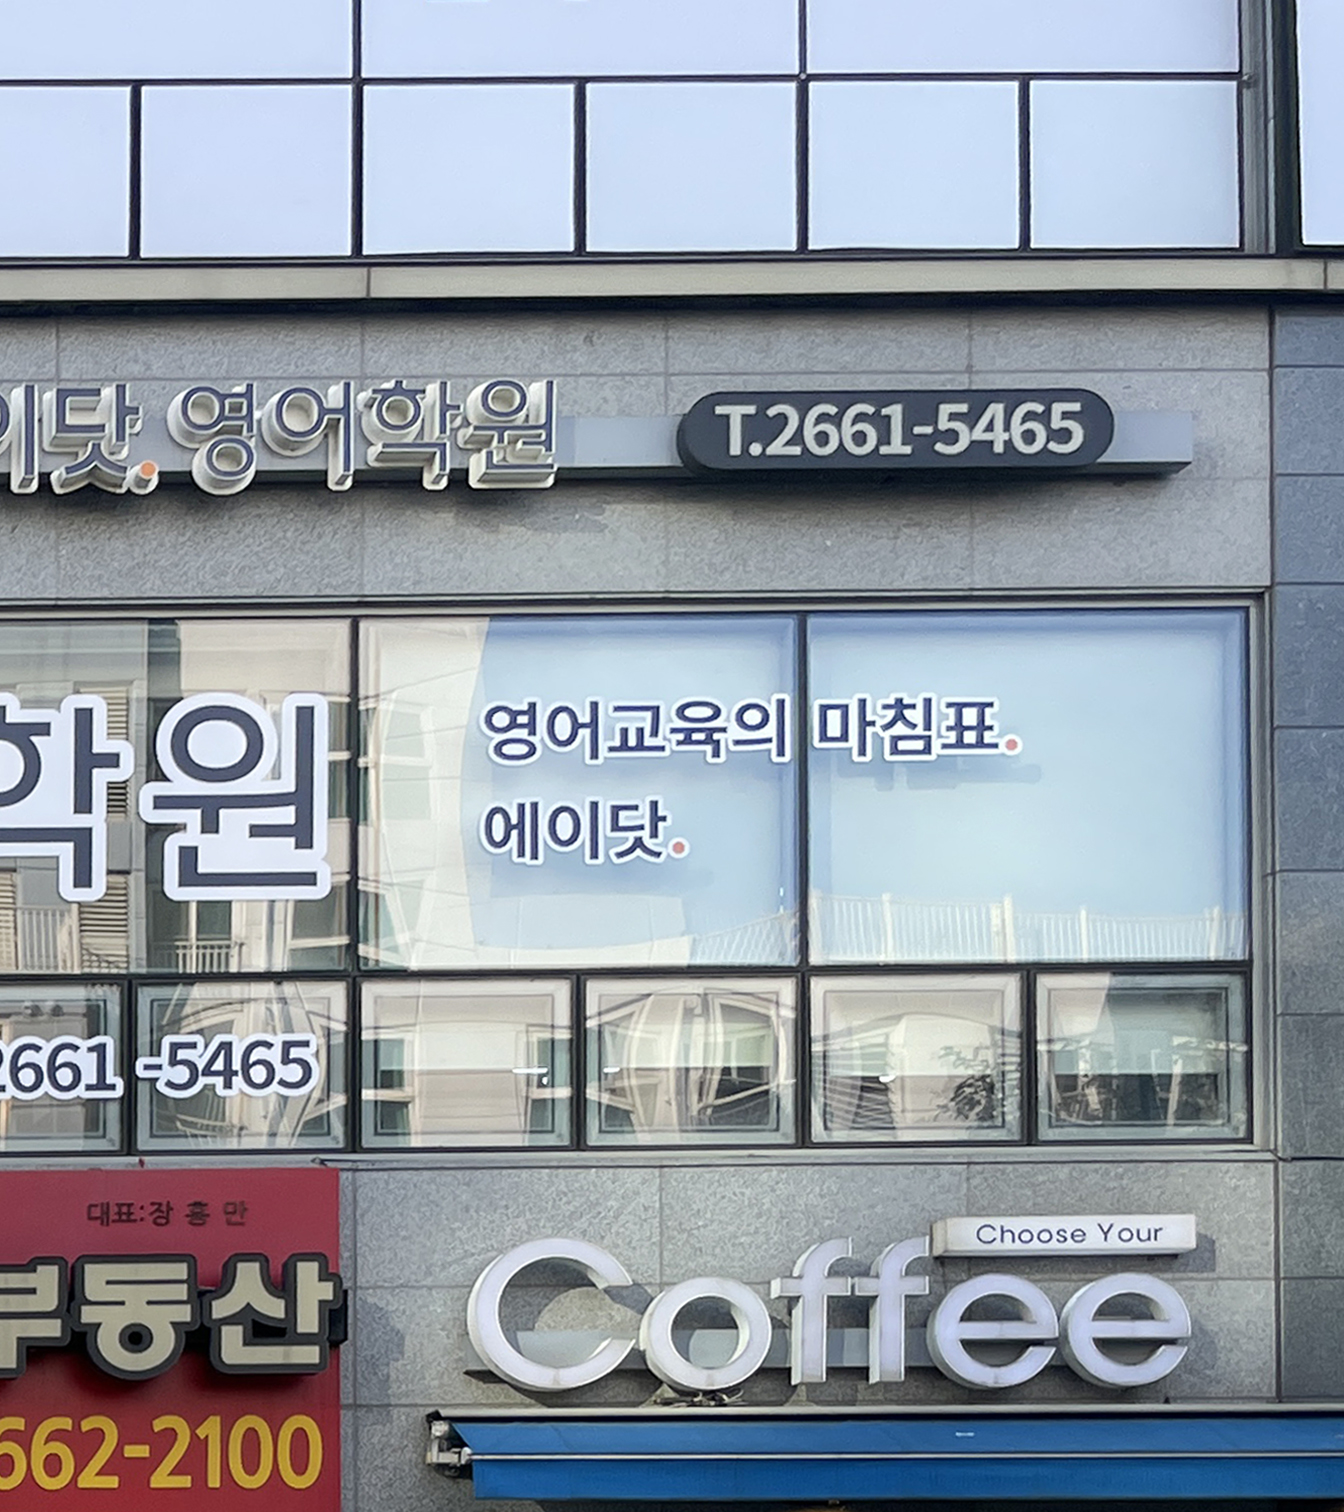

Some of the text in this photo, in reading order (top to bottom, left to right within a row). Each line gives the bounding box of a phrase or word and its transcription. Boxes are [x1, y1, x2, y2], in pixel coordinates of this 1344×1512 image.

[170, 379, 556, 494] 영어학원
[714, 400, 1086, 458] T.2661-5465
[480, 694, 1023, 762] 영어교육의 마침표.
[479, 797, 690, 864] 에이닷.
[975, 1222, 1165, 1247] Choose Your
[467, 1236, 1192, 1391] Coffee
